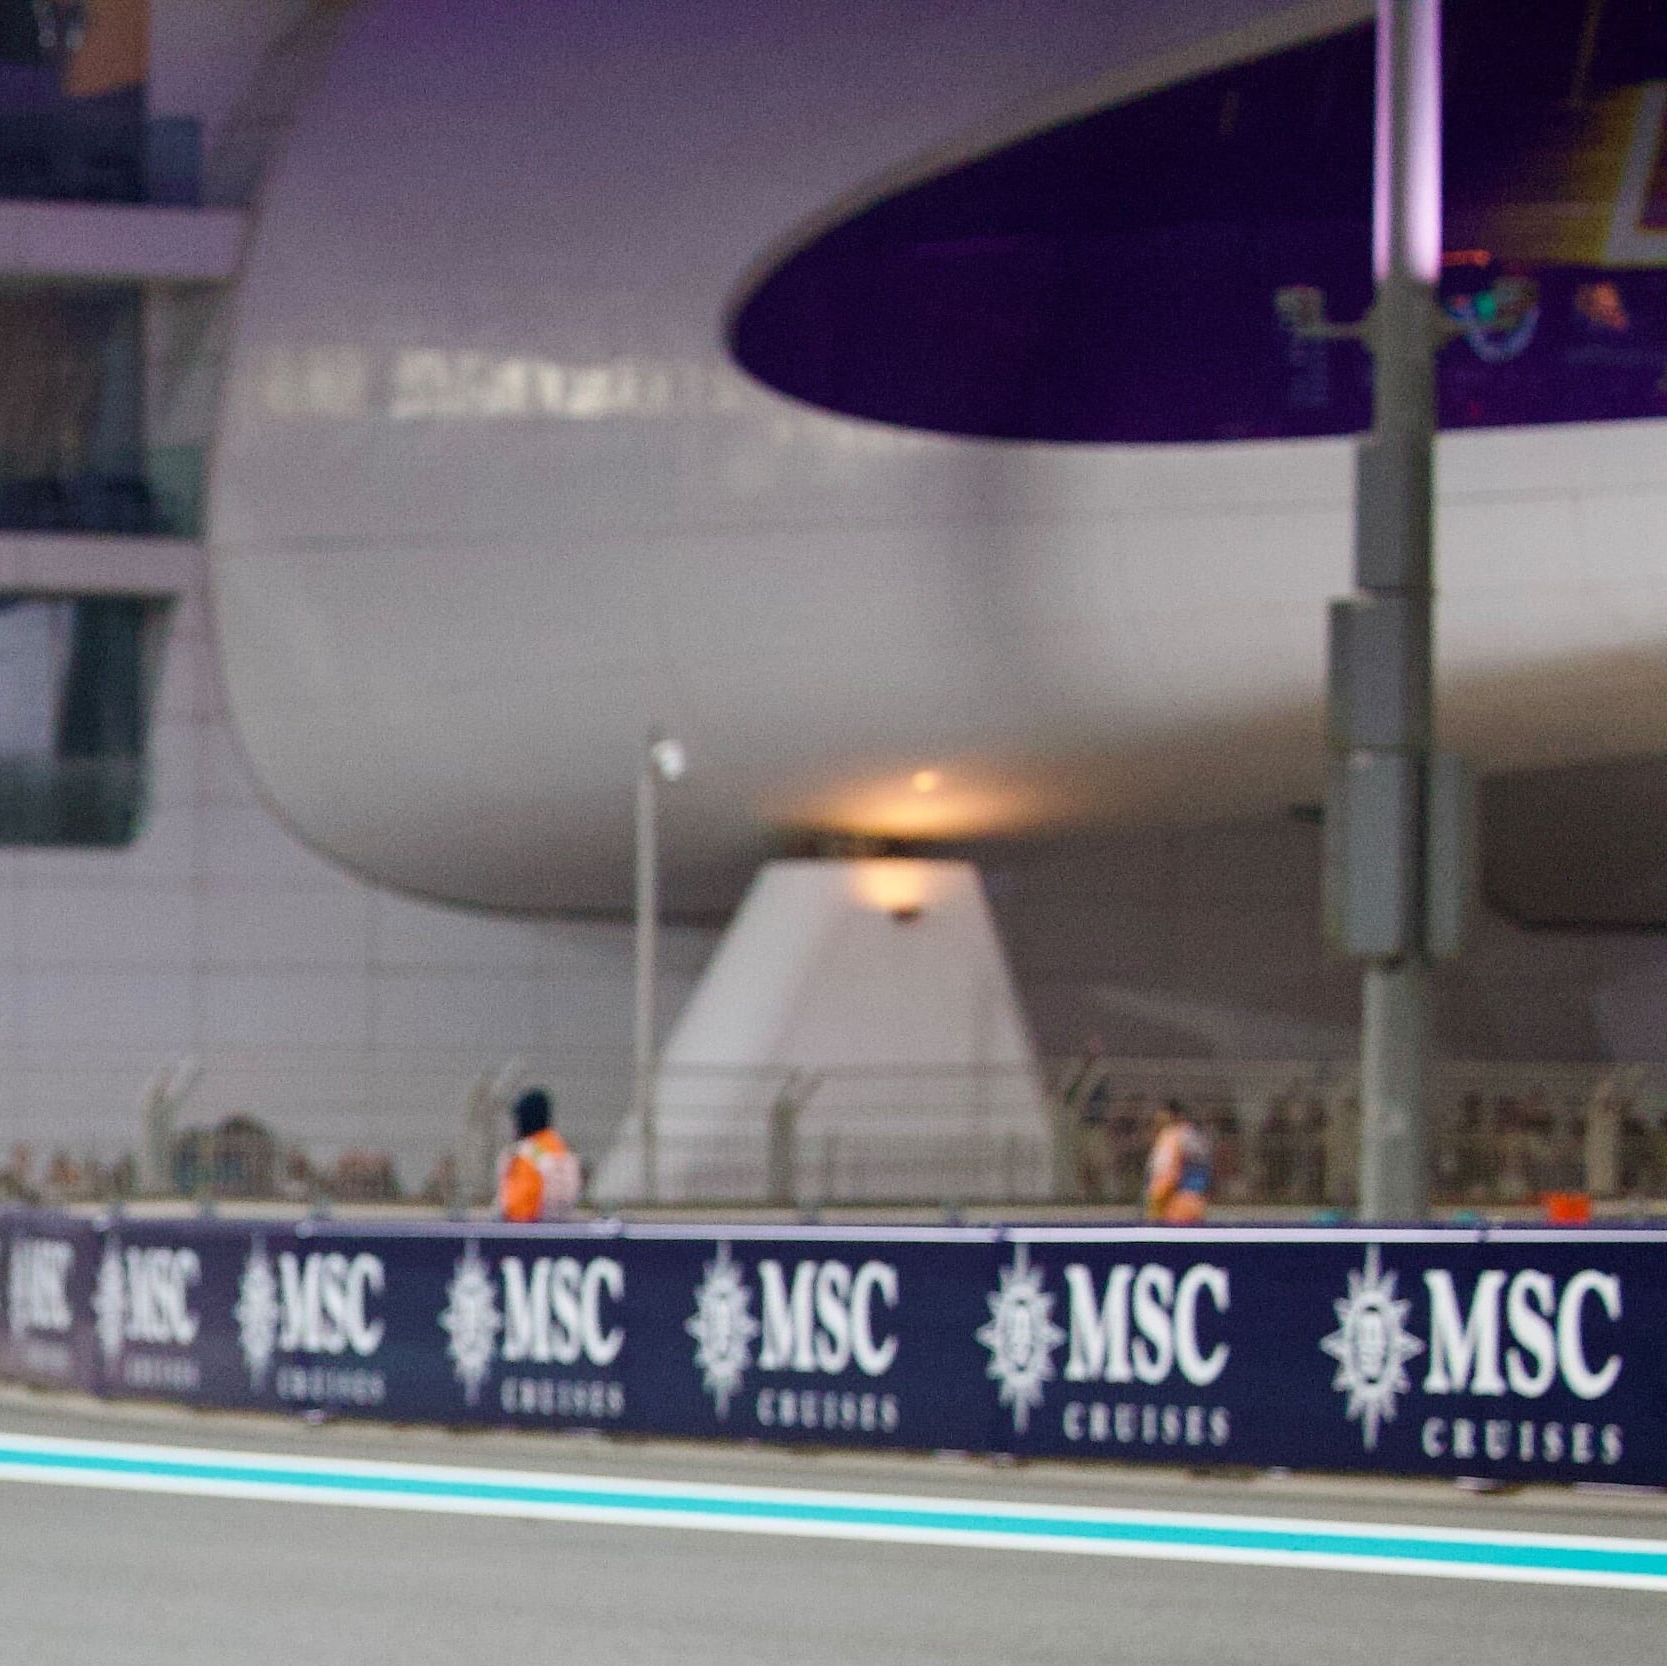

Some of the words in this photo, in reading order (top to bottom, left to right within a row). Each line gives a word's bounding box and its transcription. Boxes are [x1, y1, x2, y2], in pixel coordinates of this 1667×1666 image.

[278, 1252, 385, 1356] MSC
[501, 1256, 624, 1368] MSC
[759, 1260, 899, 1376] MSC
[1064, 1263, 1230, 1387] MSC
[1423, 1268, 1624, 1400] MSC
[500, 1376, 624, 1417] CRUISES
[757, 1387, 899, 1433] CRUISES
[1064, 1400, 1230, 1446] CRUISES
[1422, 1415, 1624, 1464] CRUISES
